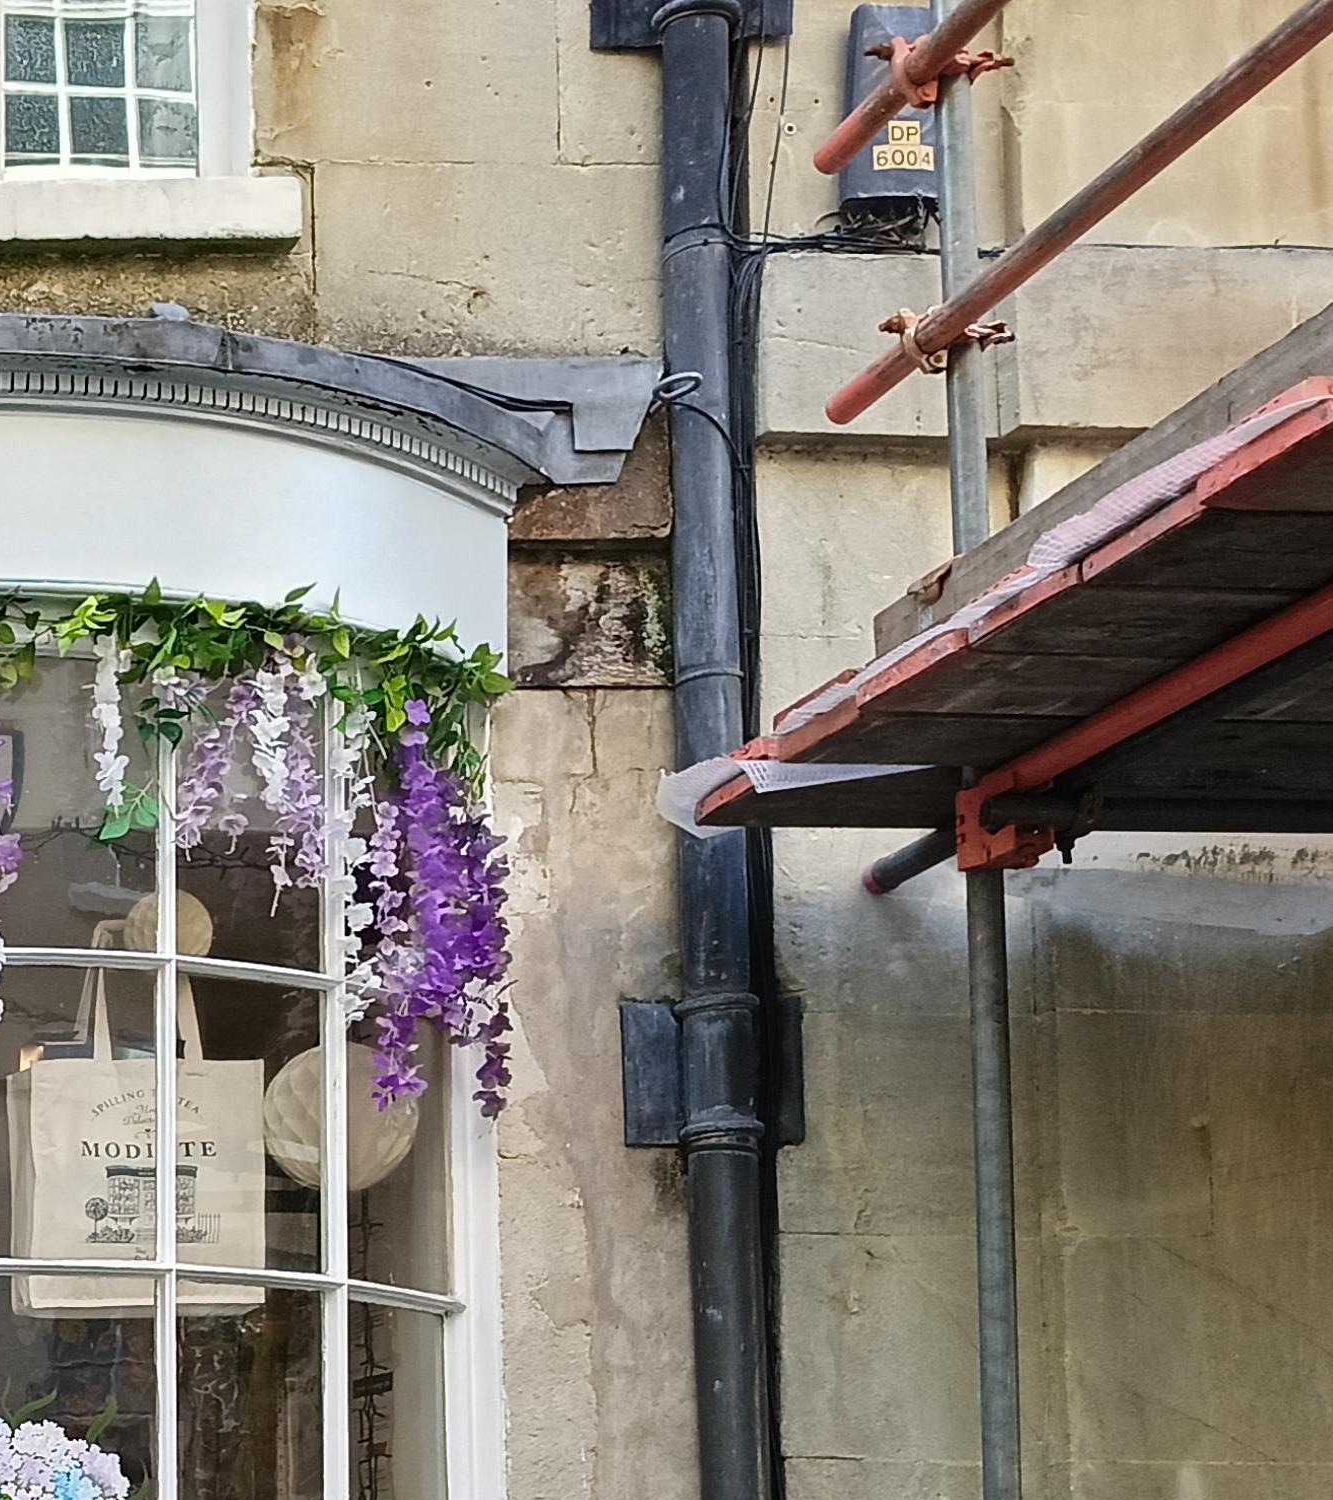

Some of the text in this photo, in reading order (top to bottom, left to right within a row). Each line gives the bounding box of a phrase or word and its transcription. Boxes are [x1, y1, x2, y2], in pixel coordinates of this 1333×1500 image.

[890, 125, 920, 142] DP
[876, 149, 932, 167] 6004
[91, 1089, 146, 1117] SPILLING
[176, 1096, 200, 1115] TEA
[80, 1140, 218, 1159] MODITE
